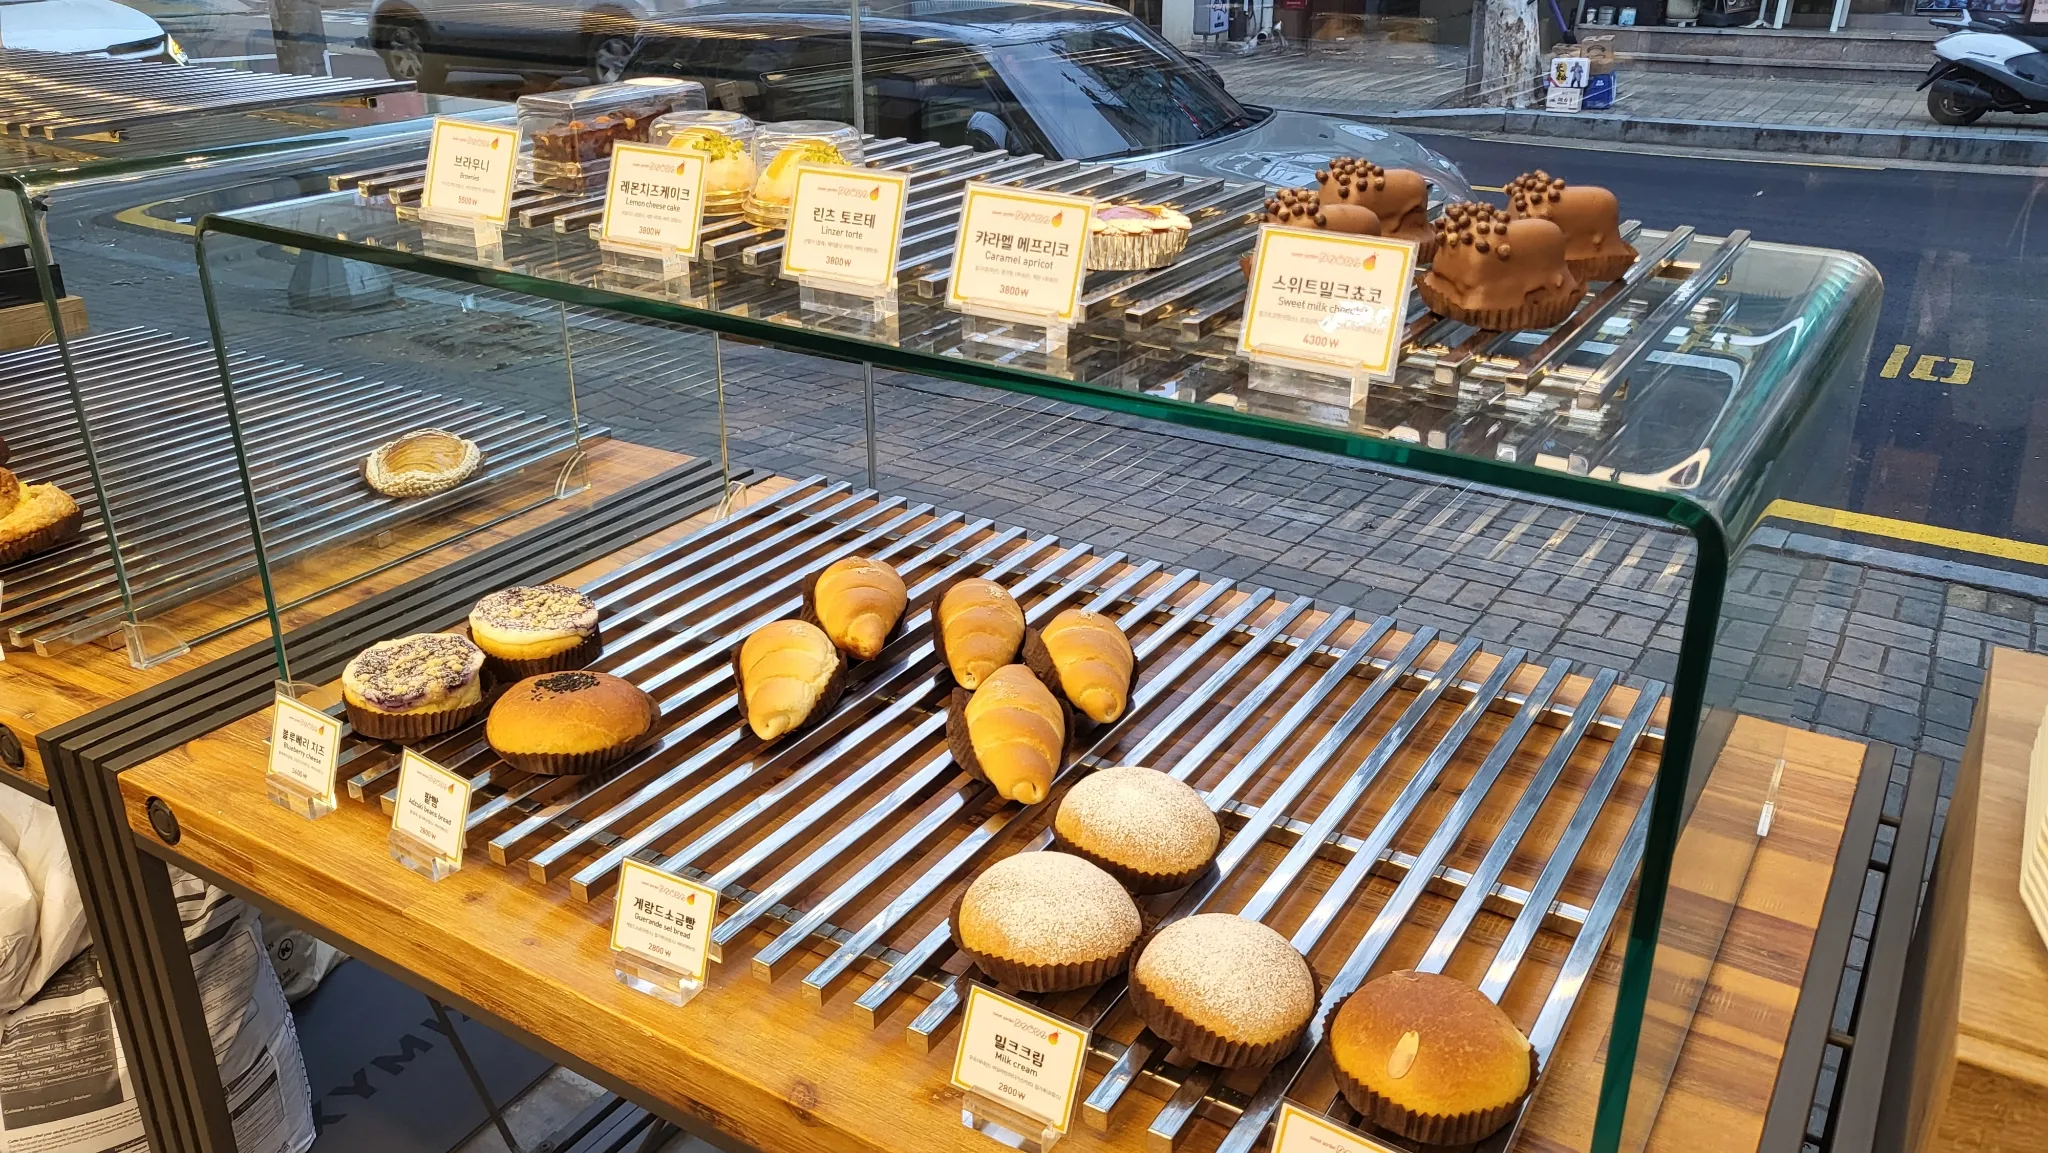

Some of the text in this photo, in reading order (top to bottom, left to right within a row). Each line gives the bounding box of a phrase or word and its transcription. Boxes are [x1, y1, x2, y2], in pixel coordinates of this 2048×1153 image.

[454, 155, 490, 173] 브라우니
[620, 180, 690, 201] 레몬치즈케이크
[625, 197, 681, 213] Lemon cheese cake
[813, 207, 876, 229] 린츠 토르테
[821, 225, 864, 240] Linzer torte
[1016, 236, 1069, 258] 에프리코
[985, 250, 1054, 270] Caramel apricot
[1271, 275, 1382, 304] 스위트밀크쵸코
[1278, 296, 1306, 310] Sweet
[1307, 300, 1328, 313] milk
[1302, 334, 1328, 346] 4300
[282, 728, 325, 757] 블루베리 치즈
[283, 741, 306, 758] Blueberry
[305, 752, 322, 765] cheese
[437, 812, 452, 826] bread
[633, 896, 697, 931] 게랑드소금빵
[634, 912, 663, 929] Guerande
[663, 924, 673, 933] sel
[673, 926, 691, 940] bread
[647, 942, 664, 955] 2800
[994, 1033, 1045, 1069] 밀크크림
[994, 1050, 1038, 1078] Milk cream
